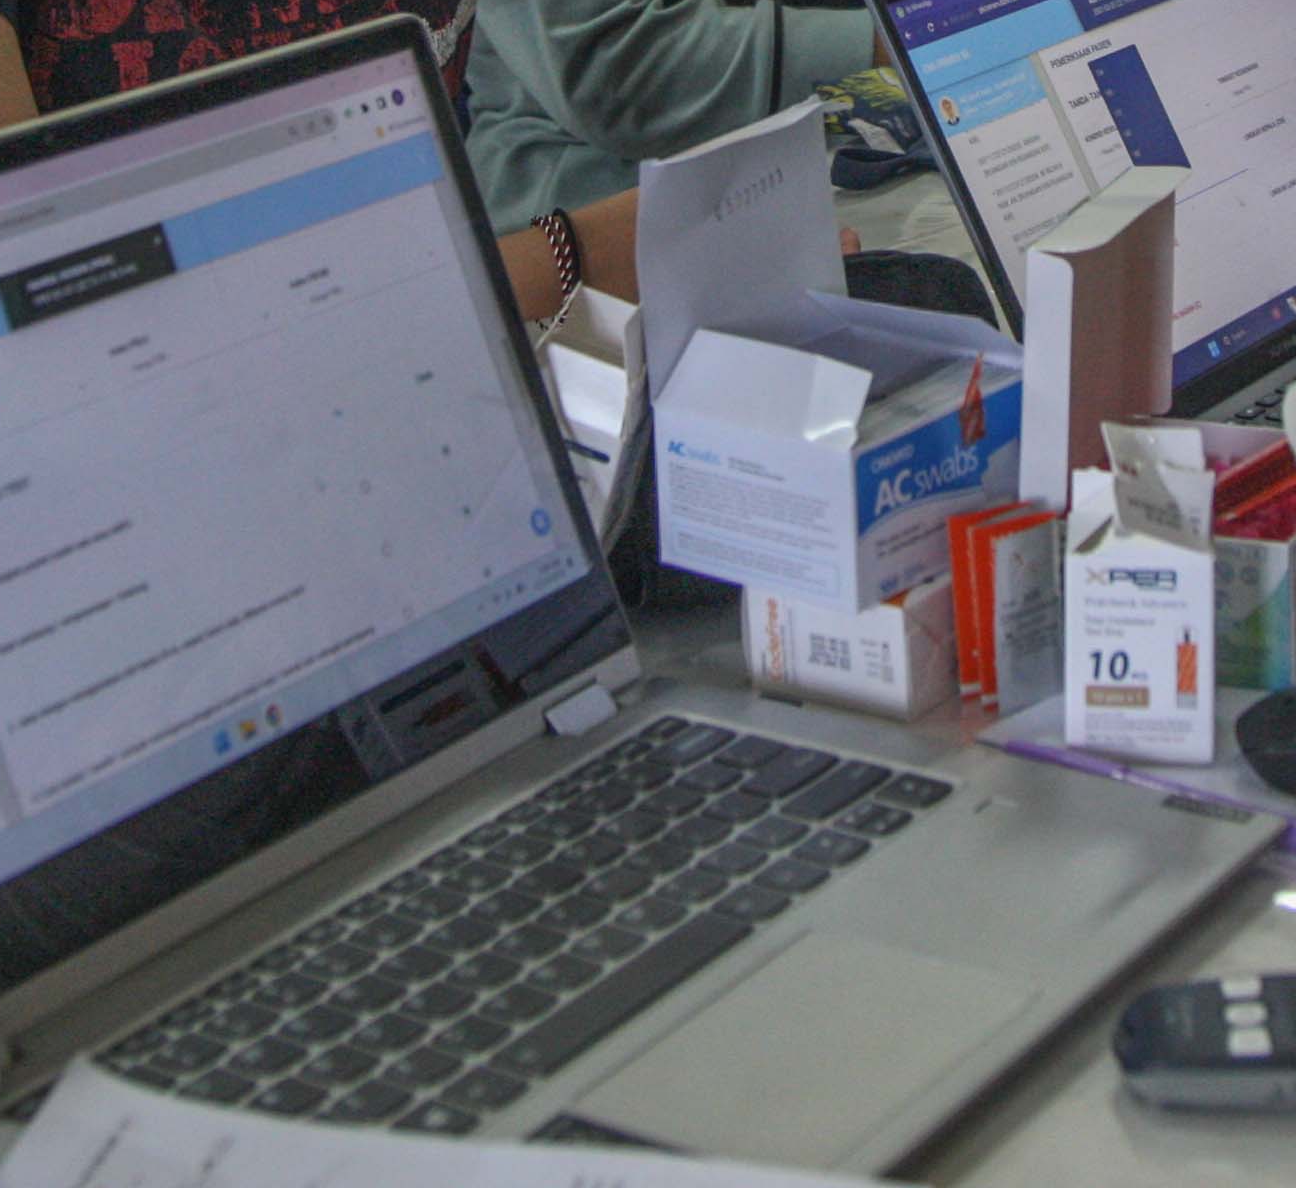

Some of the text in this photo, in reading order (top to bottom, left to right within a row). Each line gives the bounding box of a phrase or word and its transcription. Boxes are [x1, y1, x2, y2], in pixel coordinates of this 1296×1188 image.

[875, 444, 979, 516] AC swabs
[1090, 649, 1130, 682] 10
